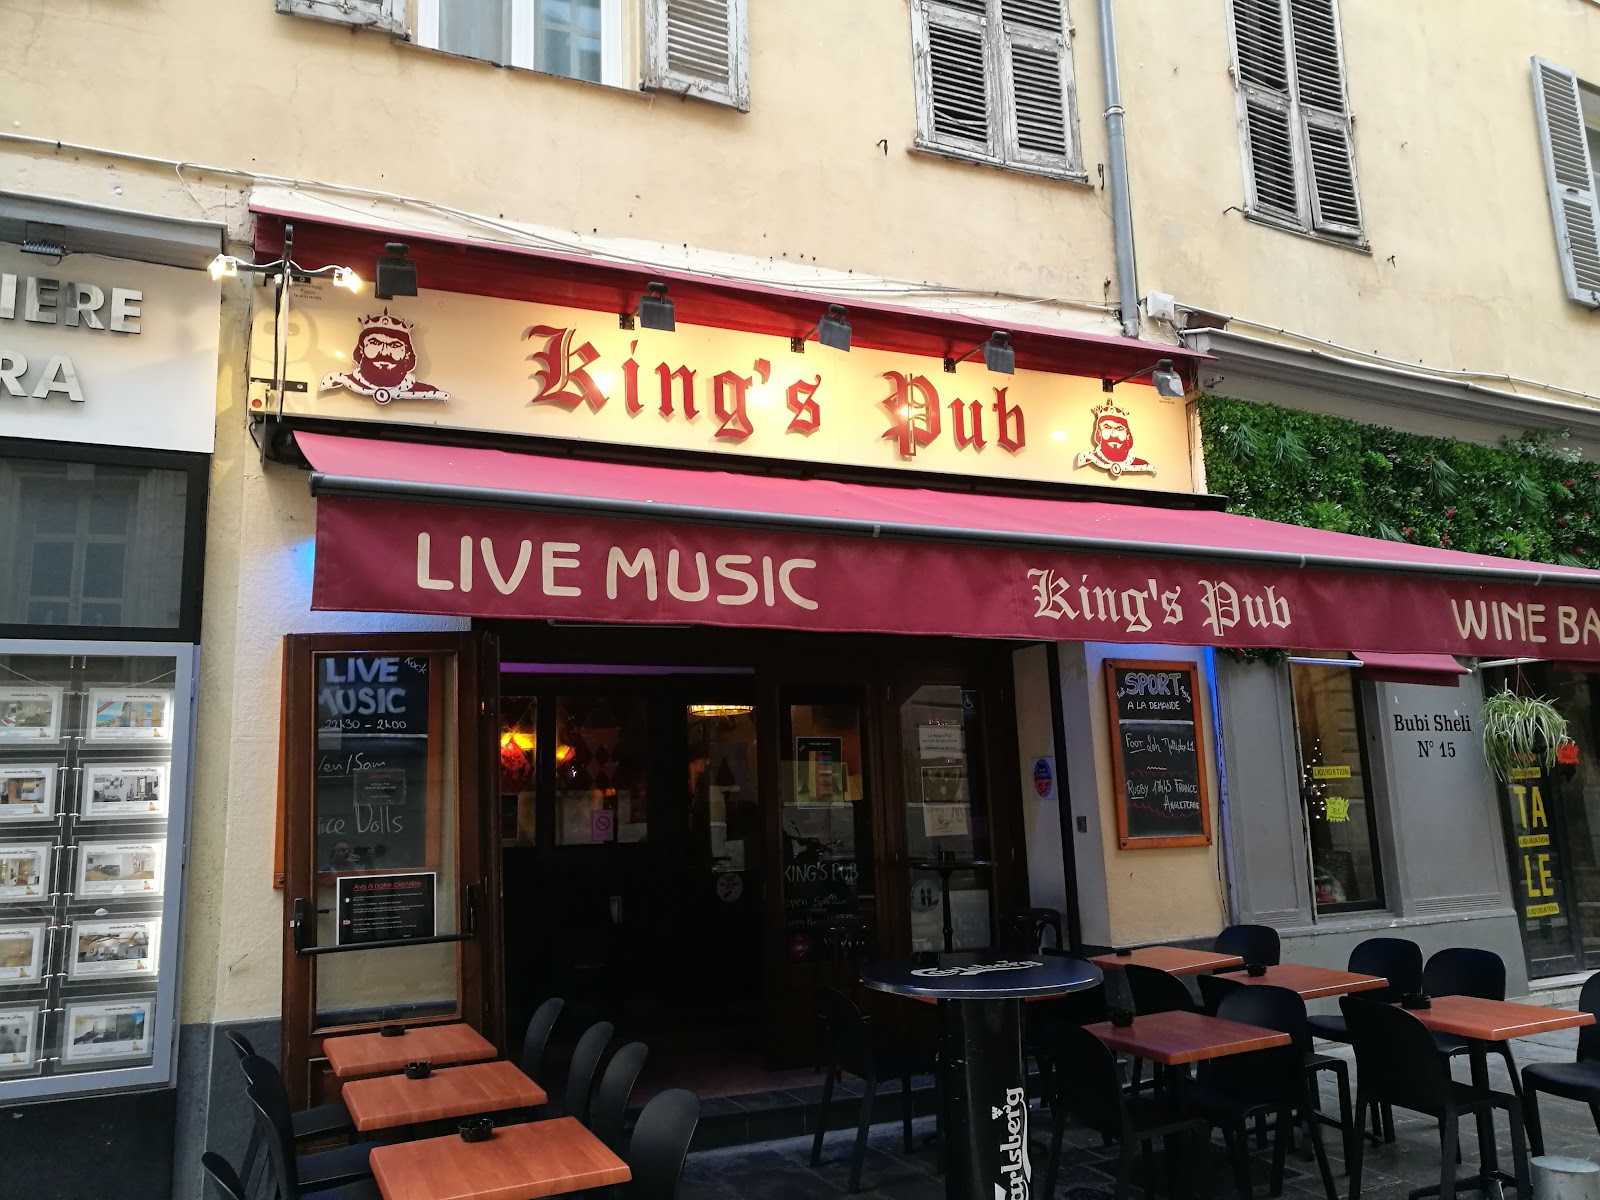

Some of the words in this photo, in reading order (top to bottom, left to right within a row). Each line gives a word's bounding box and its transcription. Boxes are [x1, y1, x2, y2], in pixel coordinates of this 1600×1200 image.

[0, 273, 143, 334] IERE
[0, 350, 85, 403] RA
[528, 324, 822, 441] King's
[881, 370, 1026, 457] Pub
[417, 532, 582, 597] LIVE
[605, 546, 819, 611] MUSIC
[1027, 567, 1184, 633] King's
[1197, 579, 1292, 637] Pub
[1451, 598, 1547, 643] WINE
[325, 657, 400, 682] LIVE
[1124, 672, 1182, 696] SPORT
[1127, 701, 1135, 710] A
[1136, 702, 1147, 710] LA
[1149, 701, 1181, 710] DEMANDE
[376, 719, 407, 730] 2h00
[1393, 714, 1430, 732] Bubi
[1433, 714, 1472, 732] Sheli
[1417, 740, 1434, 758] N°
[1439, 741, 1456, 758] 15
[1314, 768, 1350, 777] LIQUIDATION
[354, 803, 411, 834] Dolls
[1513, 786, 1548, 828] TA
[1519, 835, 1549, 845] LIQUIDATION
[1523, 854, 1554, 897] LE
[1527, 904, 1558, 916] LIQUIDATION
